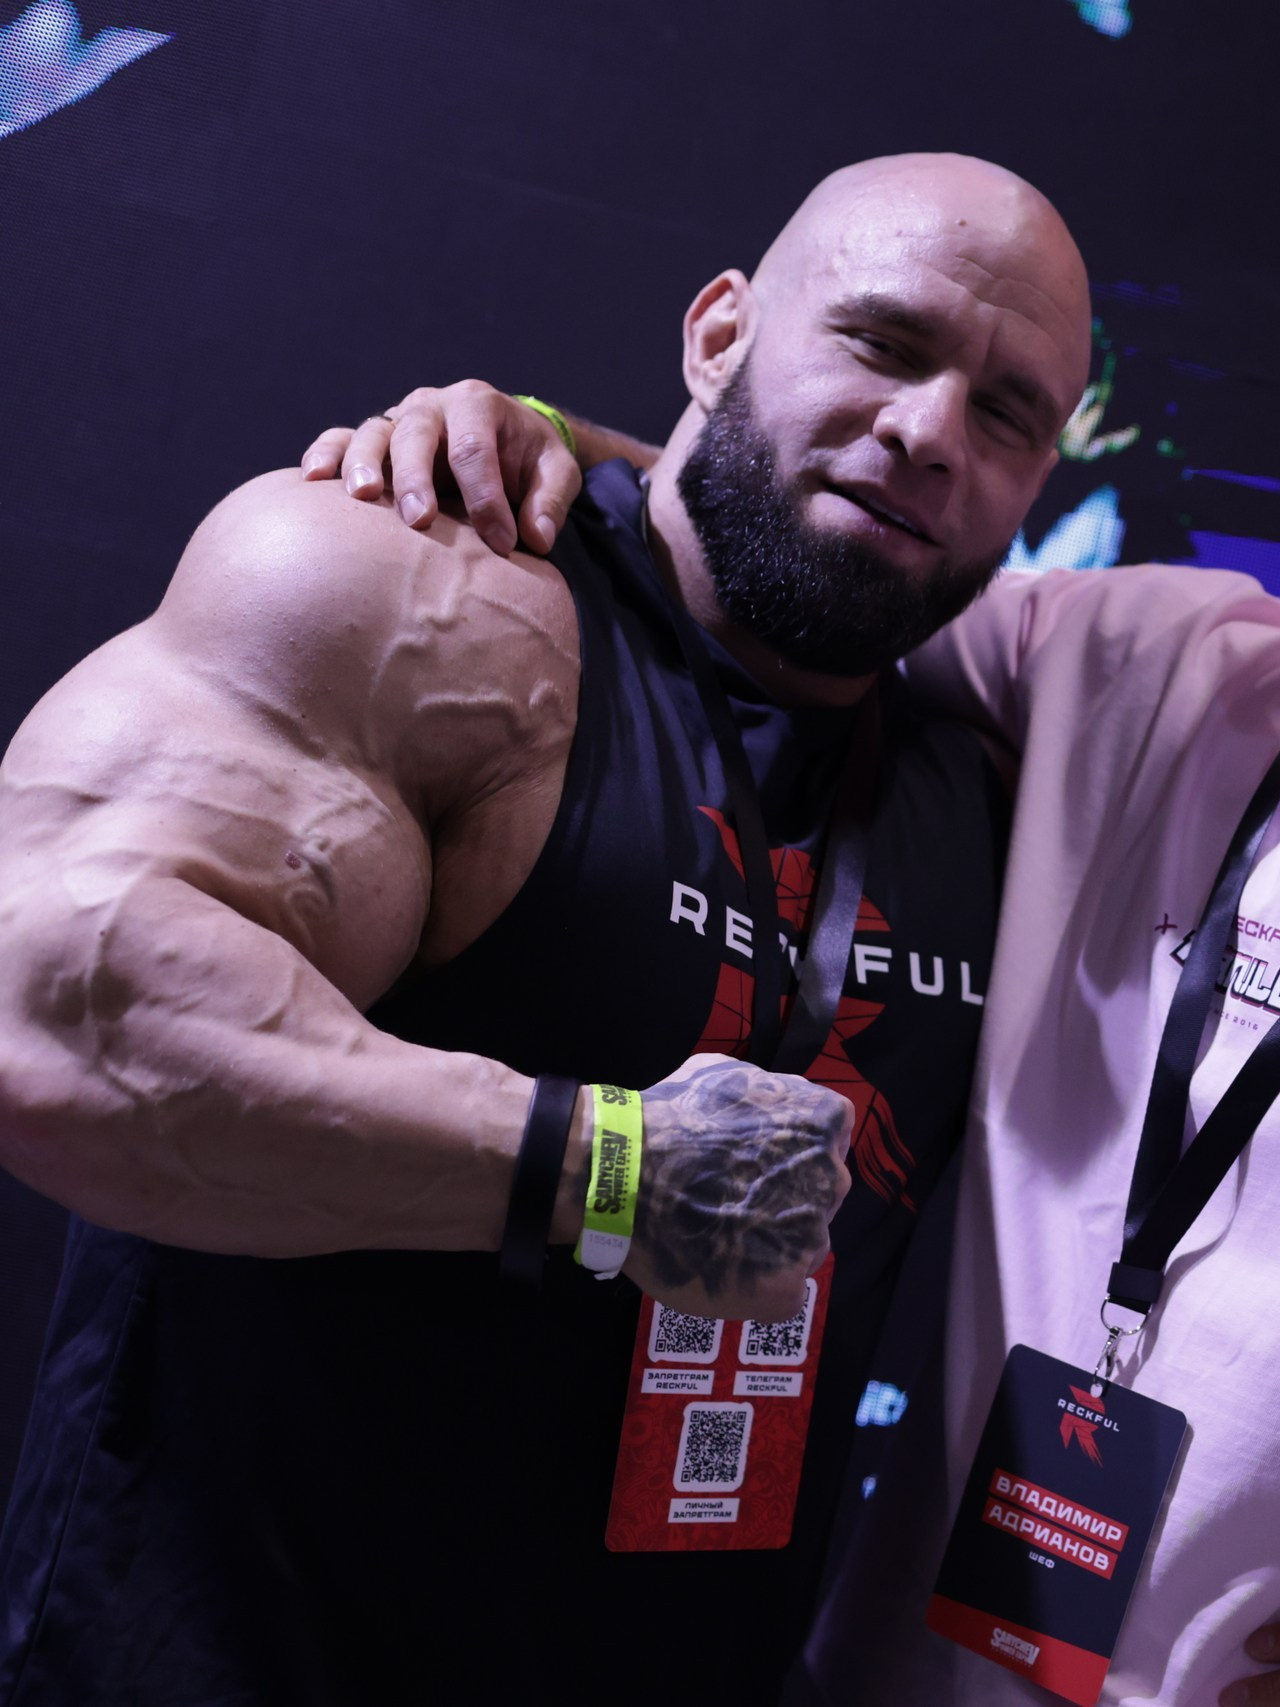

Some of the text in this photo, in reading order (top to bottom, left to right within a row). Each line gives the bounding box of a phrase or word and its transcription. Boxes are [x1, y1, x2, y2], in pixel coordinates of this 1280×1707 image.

[670, 880, 984, 1006] REFUL
[1233, 1016, 1259, 1031] 2016
[594, 1128, 627, 1215] SARYCHEV
[612, 1167, 625, 1200] POWER
[647, 1372, 709, 1381] ЗАПРЕТГРАМ
[745, 1375, 792, 1383] ТЕЛЕГРАМ
[656, 1382, 698, 1391] RECKFUL
[746, 1384, 788, 1393] RECKFUL
[1057, 1398, 1120, 1432] RECKFUL
[684, 1501, 724, 1510] ЛИЧНЫЙ
[995, 1475, 1122, 1541] ВЛАДИМИР
[673, 1511, 732, 1519] ЗАПРЕТГРАМ
[988, 1505, 1110, 1571] АДРИАНОВ
[1028, 1551, 1056, 1569] ШЕФ
